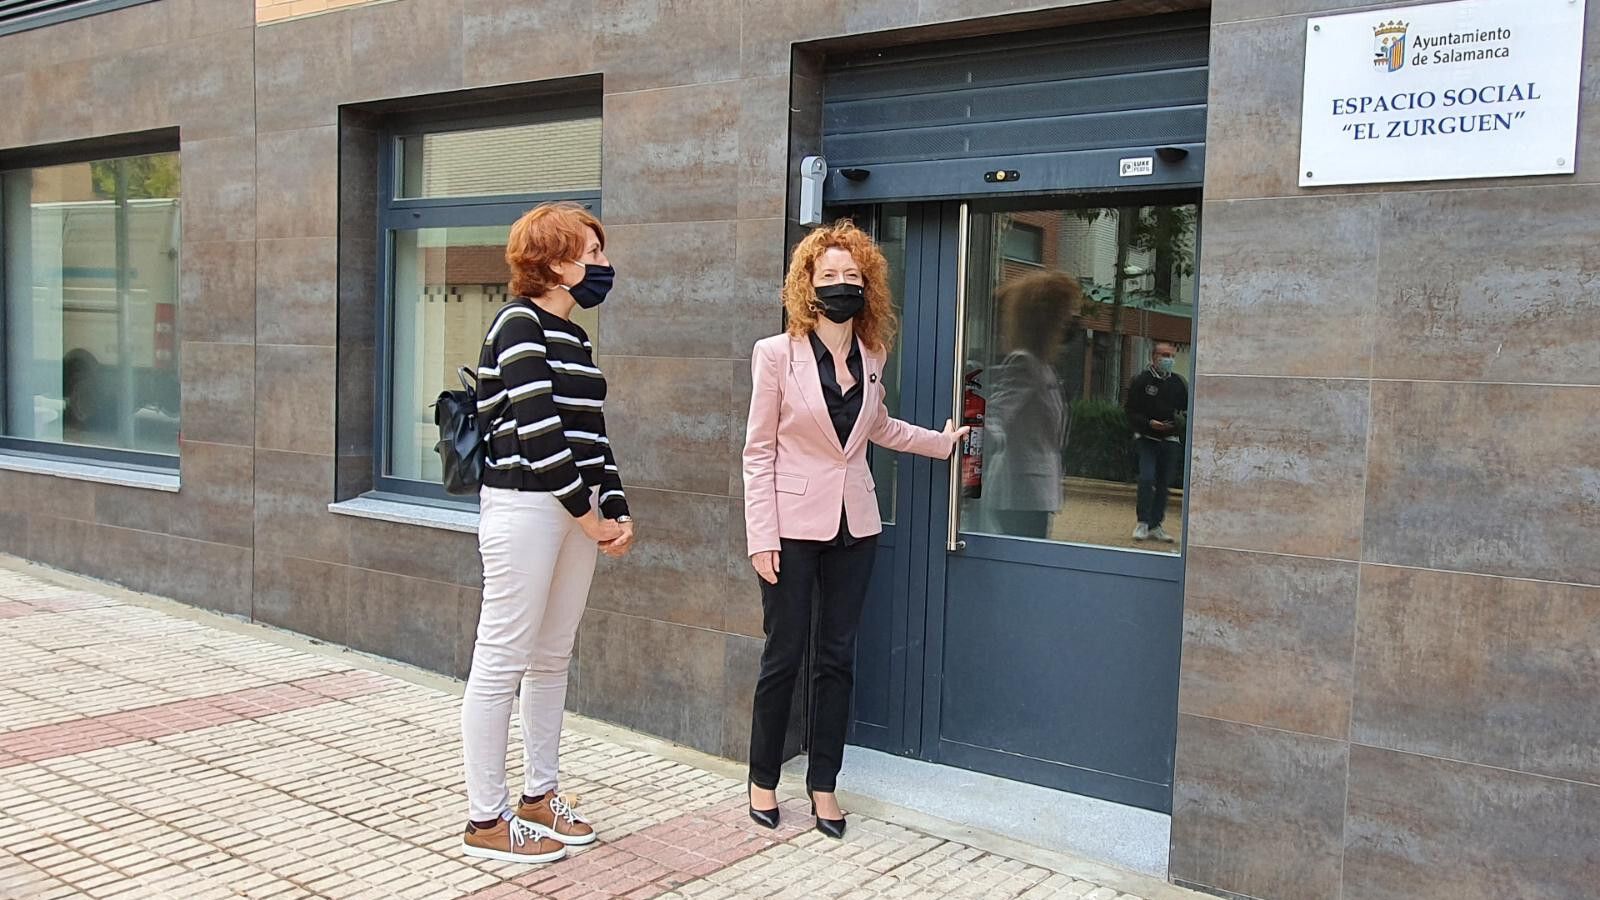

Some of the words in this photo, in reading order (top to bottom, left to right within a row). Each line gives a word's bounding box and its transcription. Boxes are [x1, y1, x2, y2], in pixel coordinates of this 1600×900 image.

[1413, 27, 1511, 50] Ayuntamiento
[1412, 49, 1428, 66] de
[1433, 47, 1510, 65] Salamanca
[1332, 92, 1436, 116] ESPACIO
[1443, 82, 1541, 107] SOCIAL
